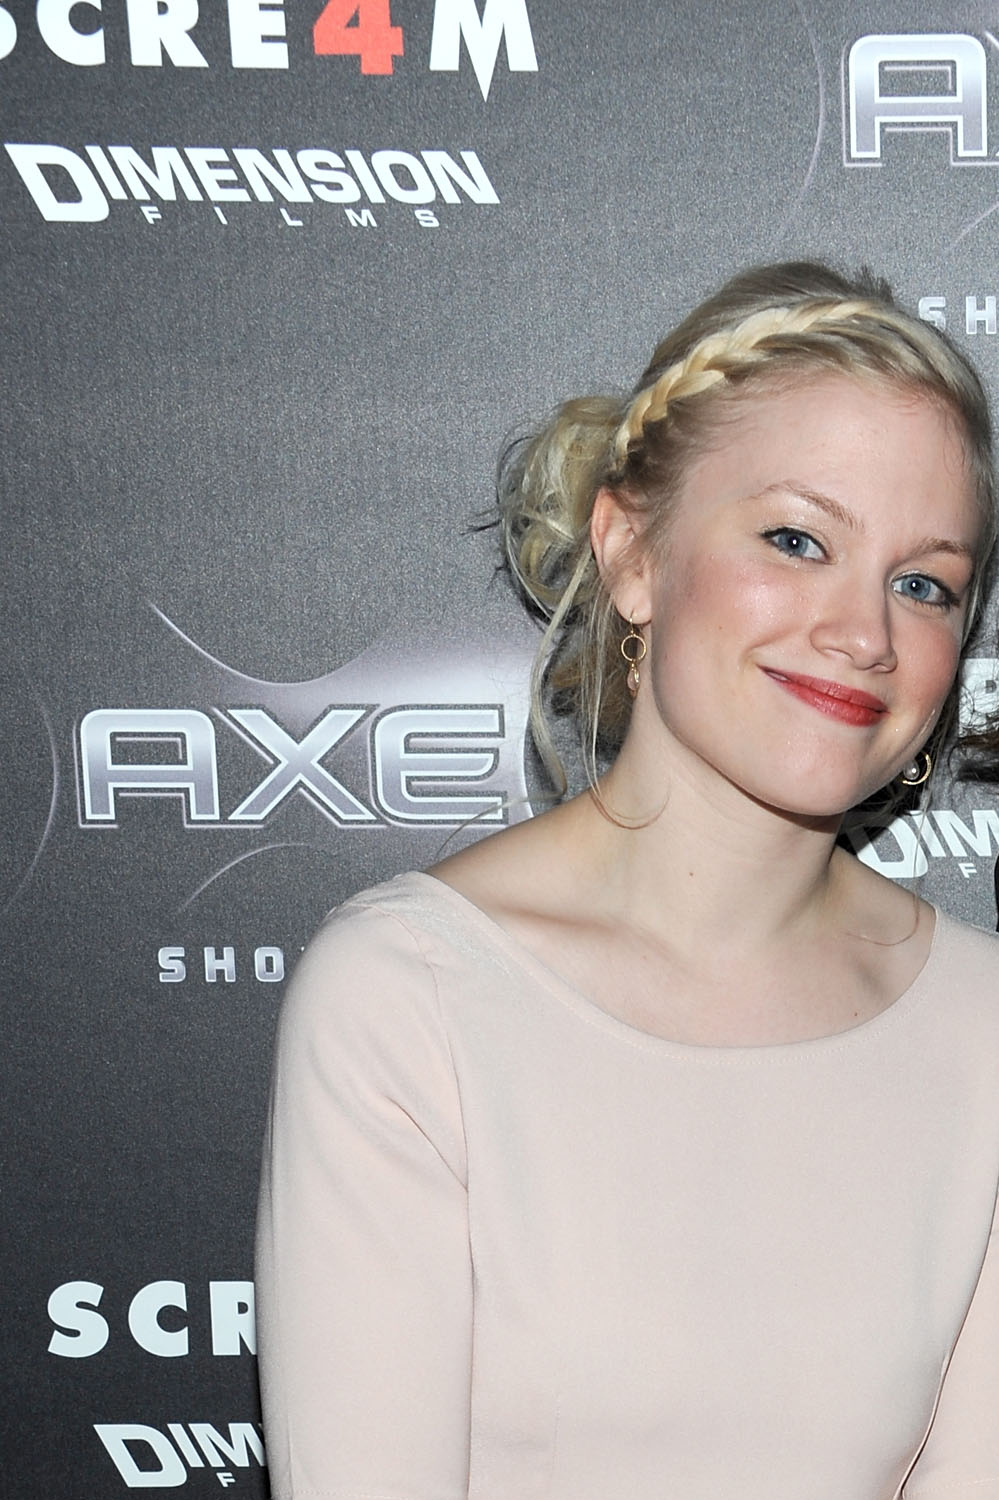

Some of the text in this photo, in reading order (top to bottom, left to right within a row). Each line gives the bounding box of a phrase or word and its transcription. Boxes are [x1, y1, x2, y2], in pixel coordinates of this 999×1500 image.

[4, 143, 501, 222] DIMENSION
[140, 206, 440, 227] FILMS
[79, 708, 505, 821] AXE
[157, 946, 306, 983] SHO
[93, 1422, 267, 1487] DIM
